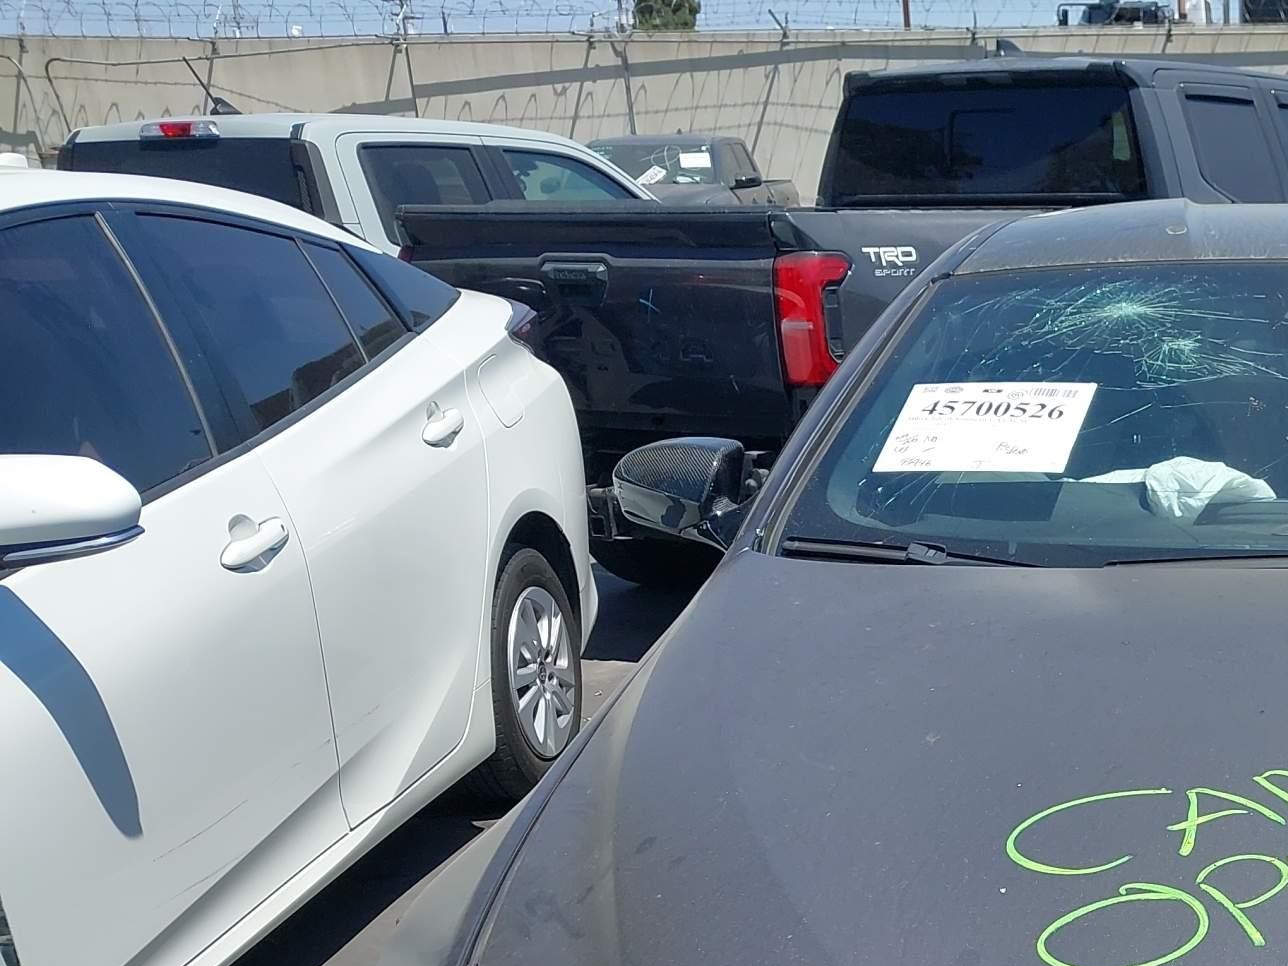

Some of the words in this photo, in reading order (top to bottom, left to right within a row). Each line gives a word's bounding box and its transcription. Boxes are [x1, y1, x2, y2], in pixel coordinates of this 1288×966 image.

[861, 246, 917, 267] TRD
[875, 268, 916, 277] SPORT
[921, 400, 1065, 420] 45700526
